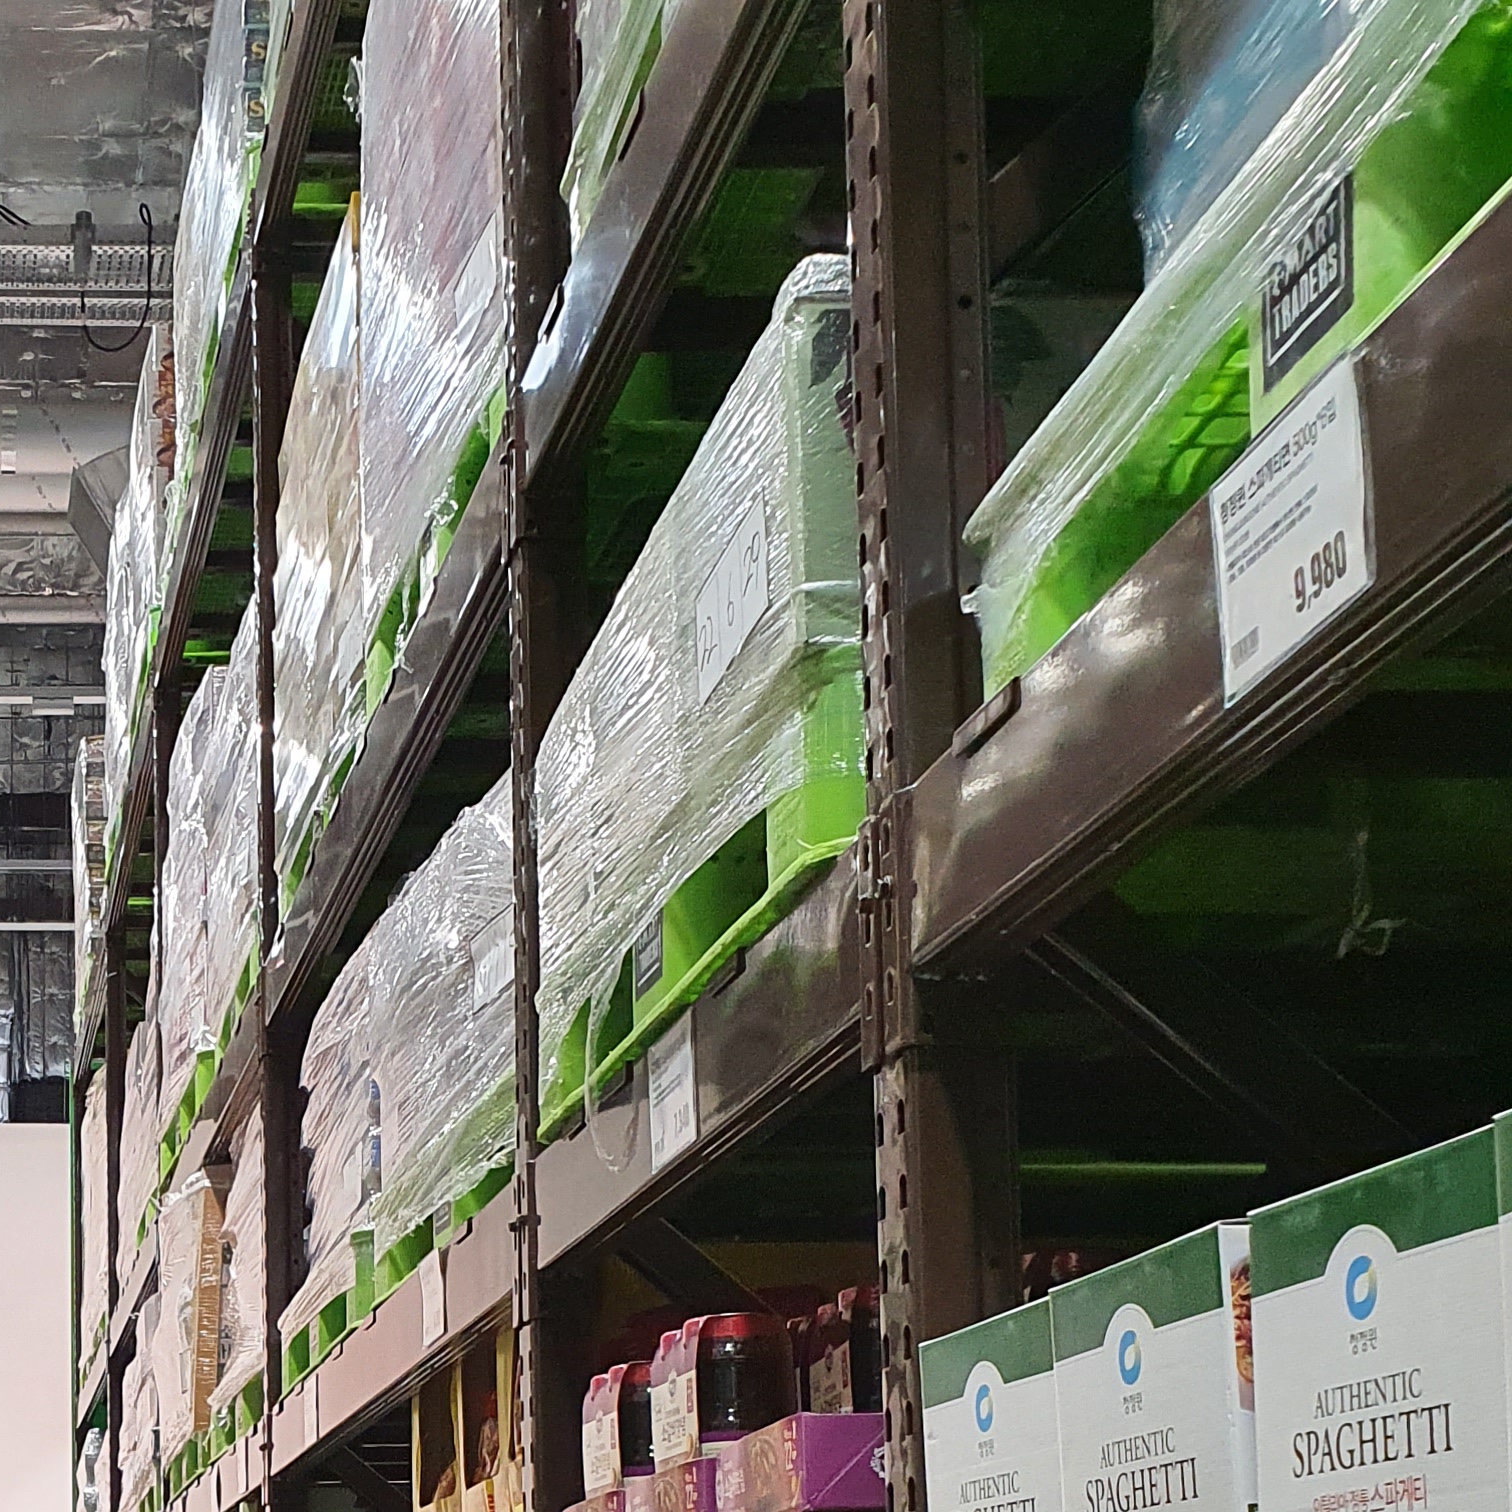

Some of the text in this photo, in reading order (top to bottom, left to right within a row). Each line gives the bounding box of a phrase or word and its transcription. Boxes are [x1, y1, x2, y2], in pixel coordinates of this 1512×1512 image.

[1272, 242, 1337, 340] TRADERS
[1294, 530, 1347, 613] 9,980
[698, 616, 718, 673] 22
[727, 571, 735, 627] 6
[1349, 1327, 1378, 1355] 청정원
[1313, 1367, 1423, 1421] AUTHENTIC
[1099, 1427, 1176, 1470] AUTHENTIC
[1293, 1402, 1454, 1479] SPAGHETTI
[959, 1470, 1020, 1505] AUTHENTIC
